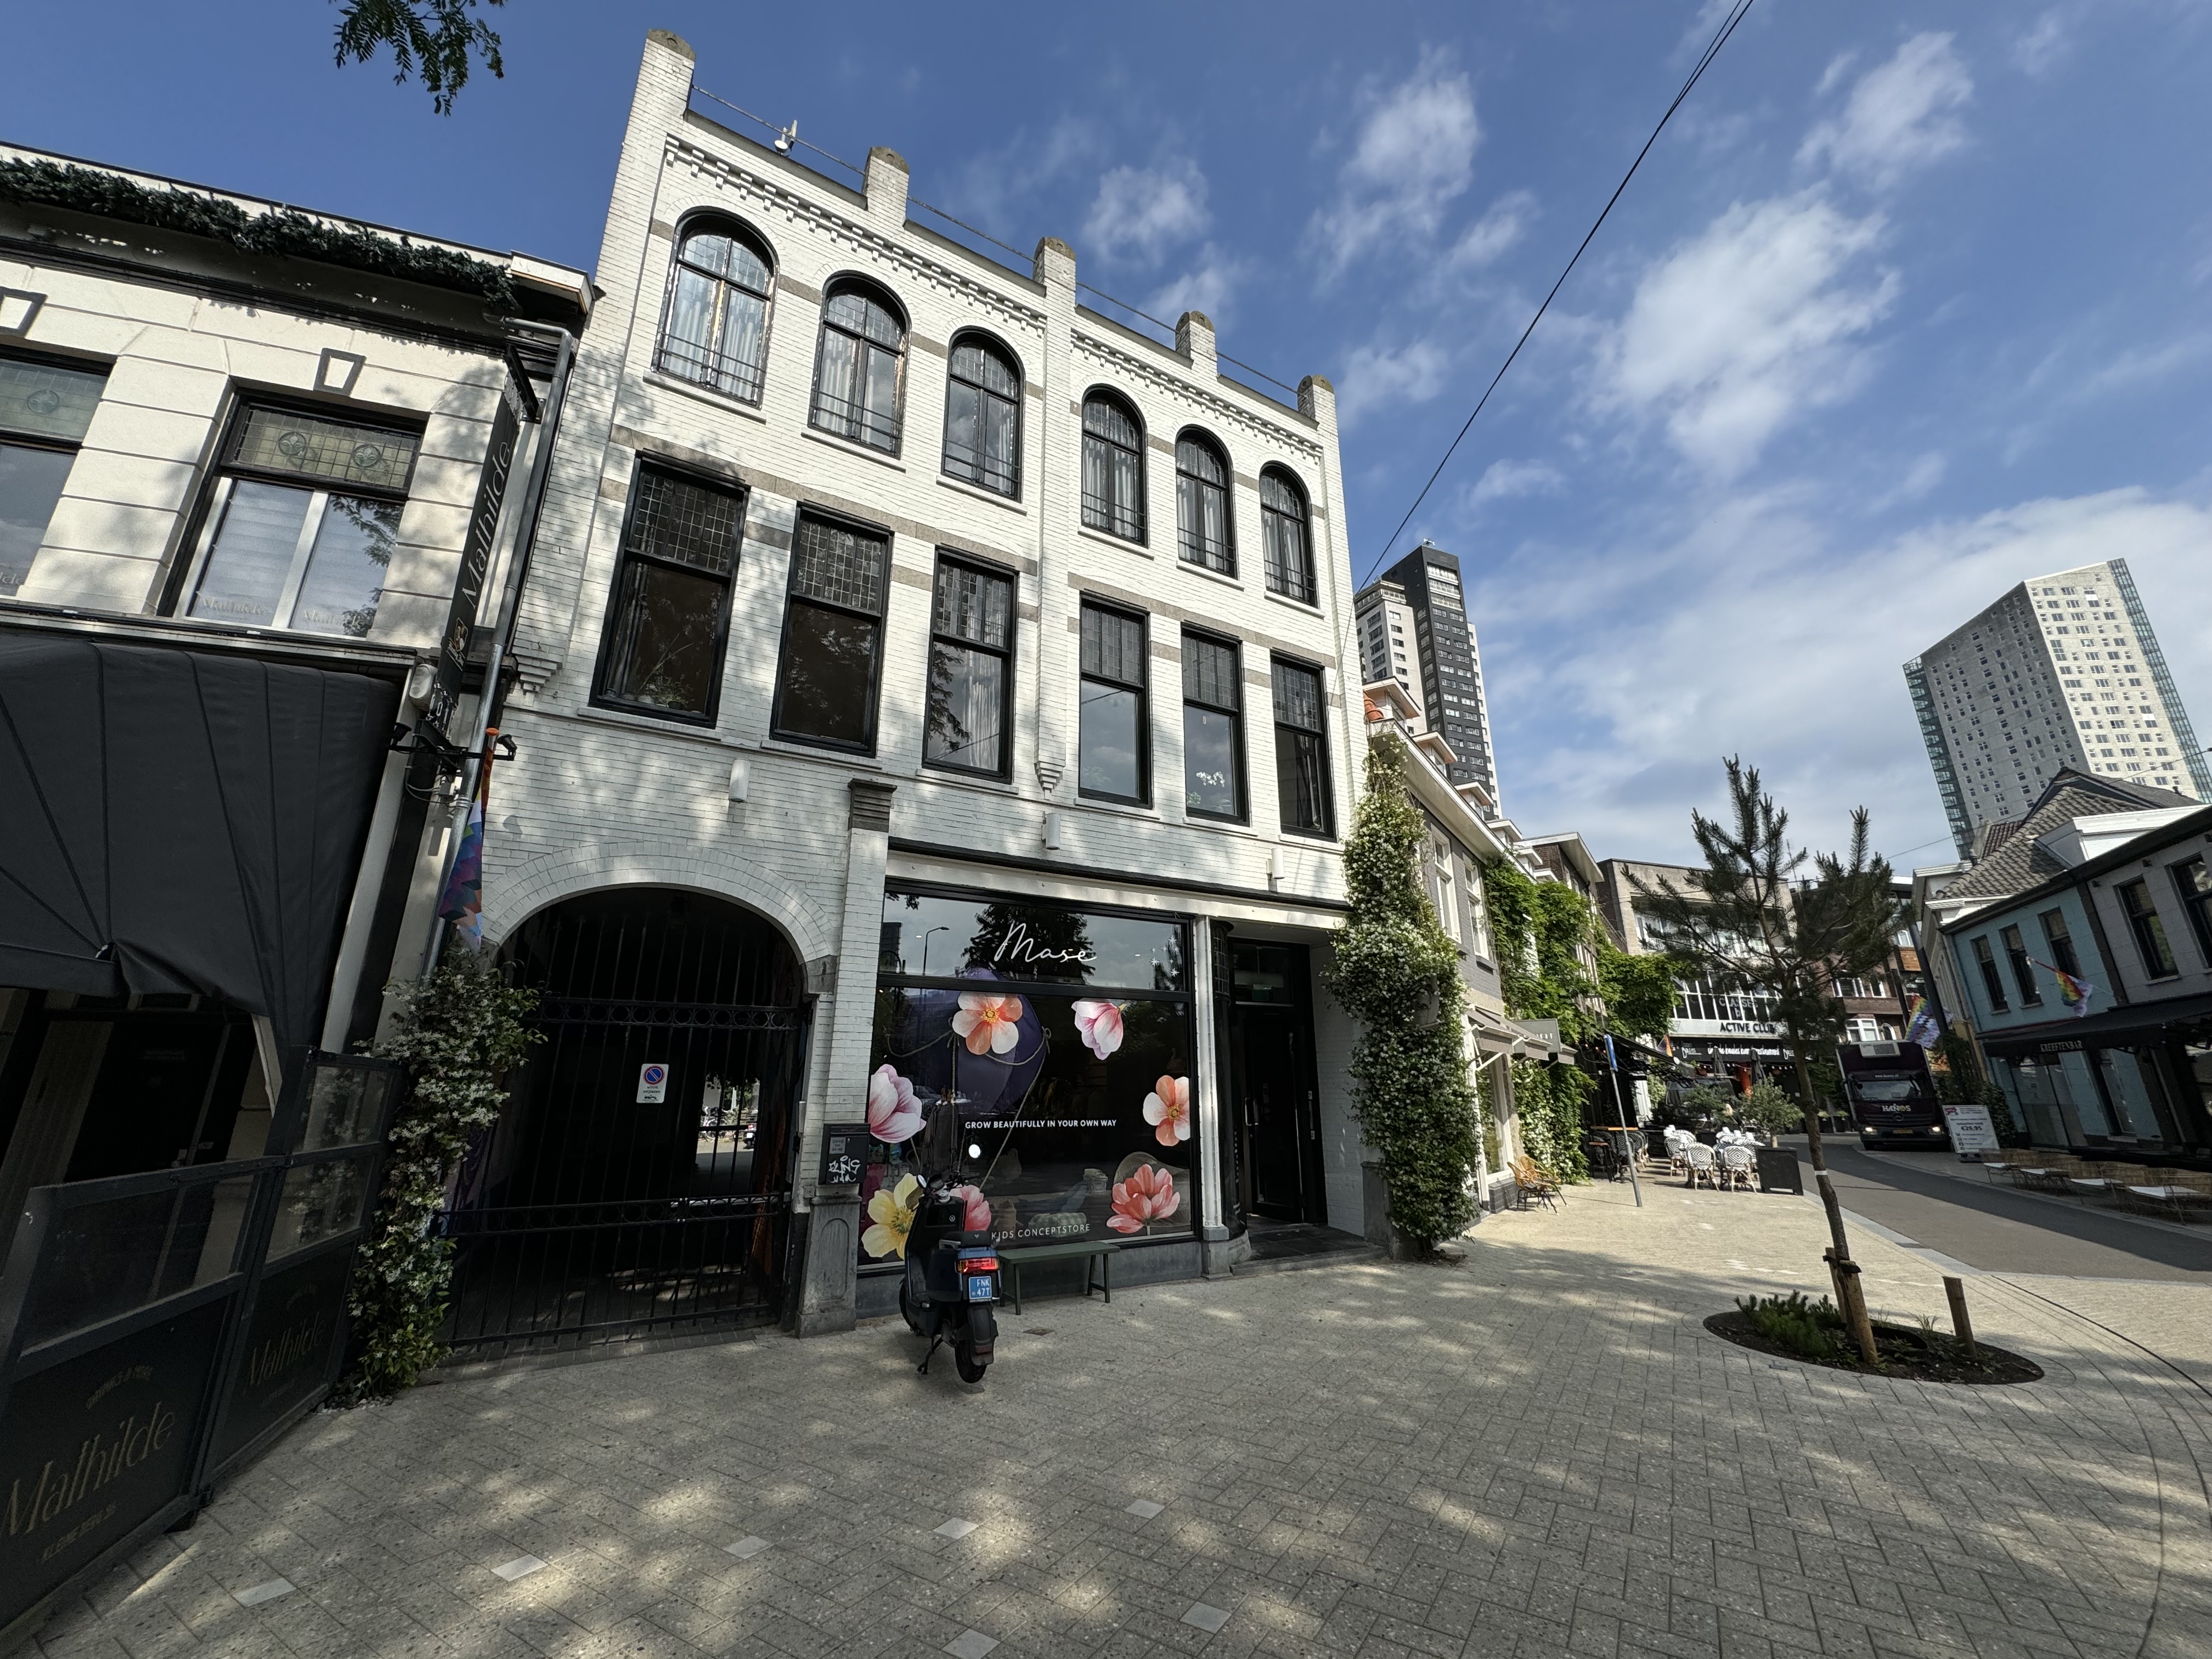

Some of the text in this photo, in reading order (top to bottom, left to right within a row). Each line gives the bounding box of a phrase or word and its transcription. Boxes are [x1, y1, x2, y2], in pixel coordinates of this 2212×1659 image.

[461, 441, 511, 610] Mathilde
[994, 923, 1097, 962] Mase
[1720, 1022, 1776, 1034] ACTIVE CLUB
[2040, 1040, 2083, 1052] KREEFTENBAR
[993, 1120, 1045, 1128] BEAUTIFULLY
[991, 1223, 1090, 1240] KIDS CONCEPTSTORE
[977, 1278, 990, 1287] FNK
[977, 1288, 990, 1296] 47T
[242, 1312, 324, 1396] Mathilde
[0, 1401, 175, 1537] Mathilde
